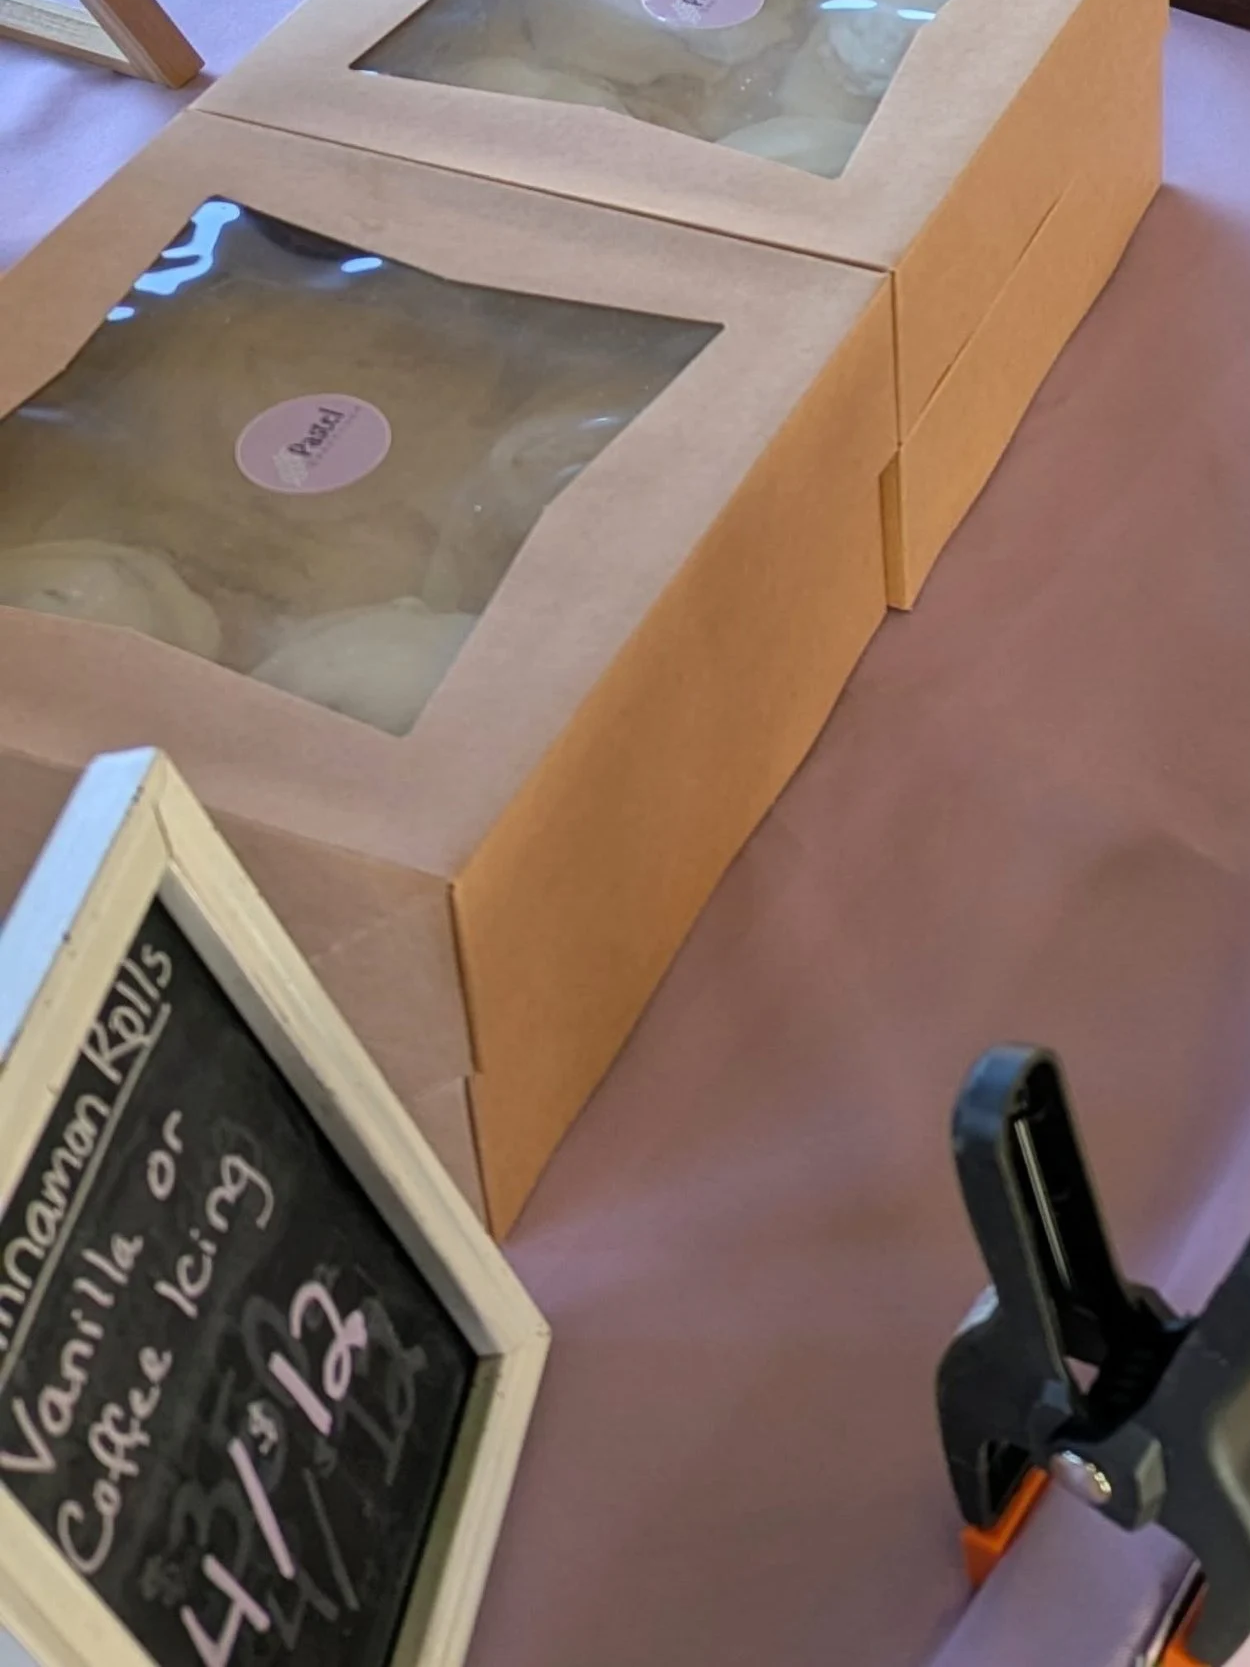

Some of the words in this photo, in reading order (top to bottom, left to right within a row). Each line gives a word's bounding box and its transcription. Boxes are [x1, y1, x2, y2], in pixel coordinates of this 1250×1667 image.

[80, 943, 172, 1084] Rolls
[0, 1232, 144, 1474] Vanilla
[146, 1109, 183, 1201] or
[58, 1345, 173, 1576] Coffee
[155, 1153, 275, 1318] Icing
